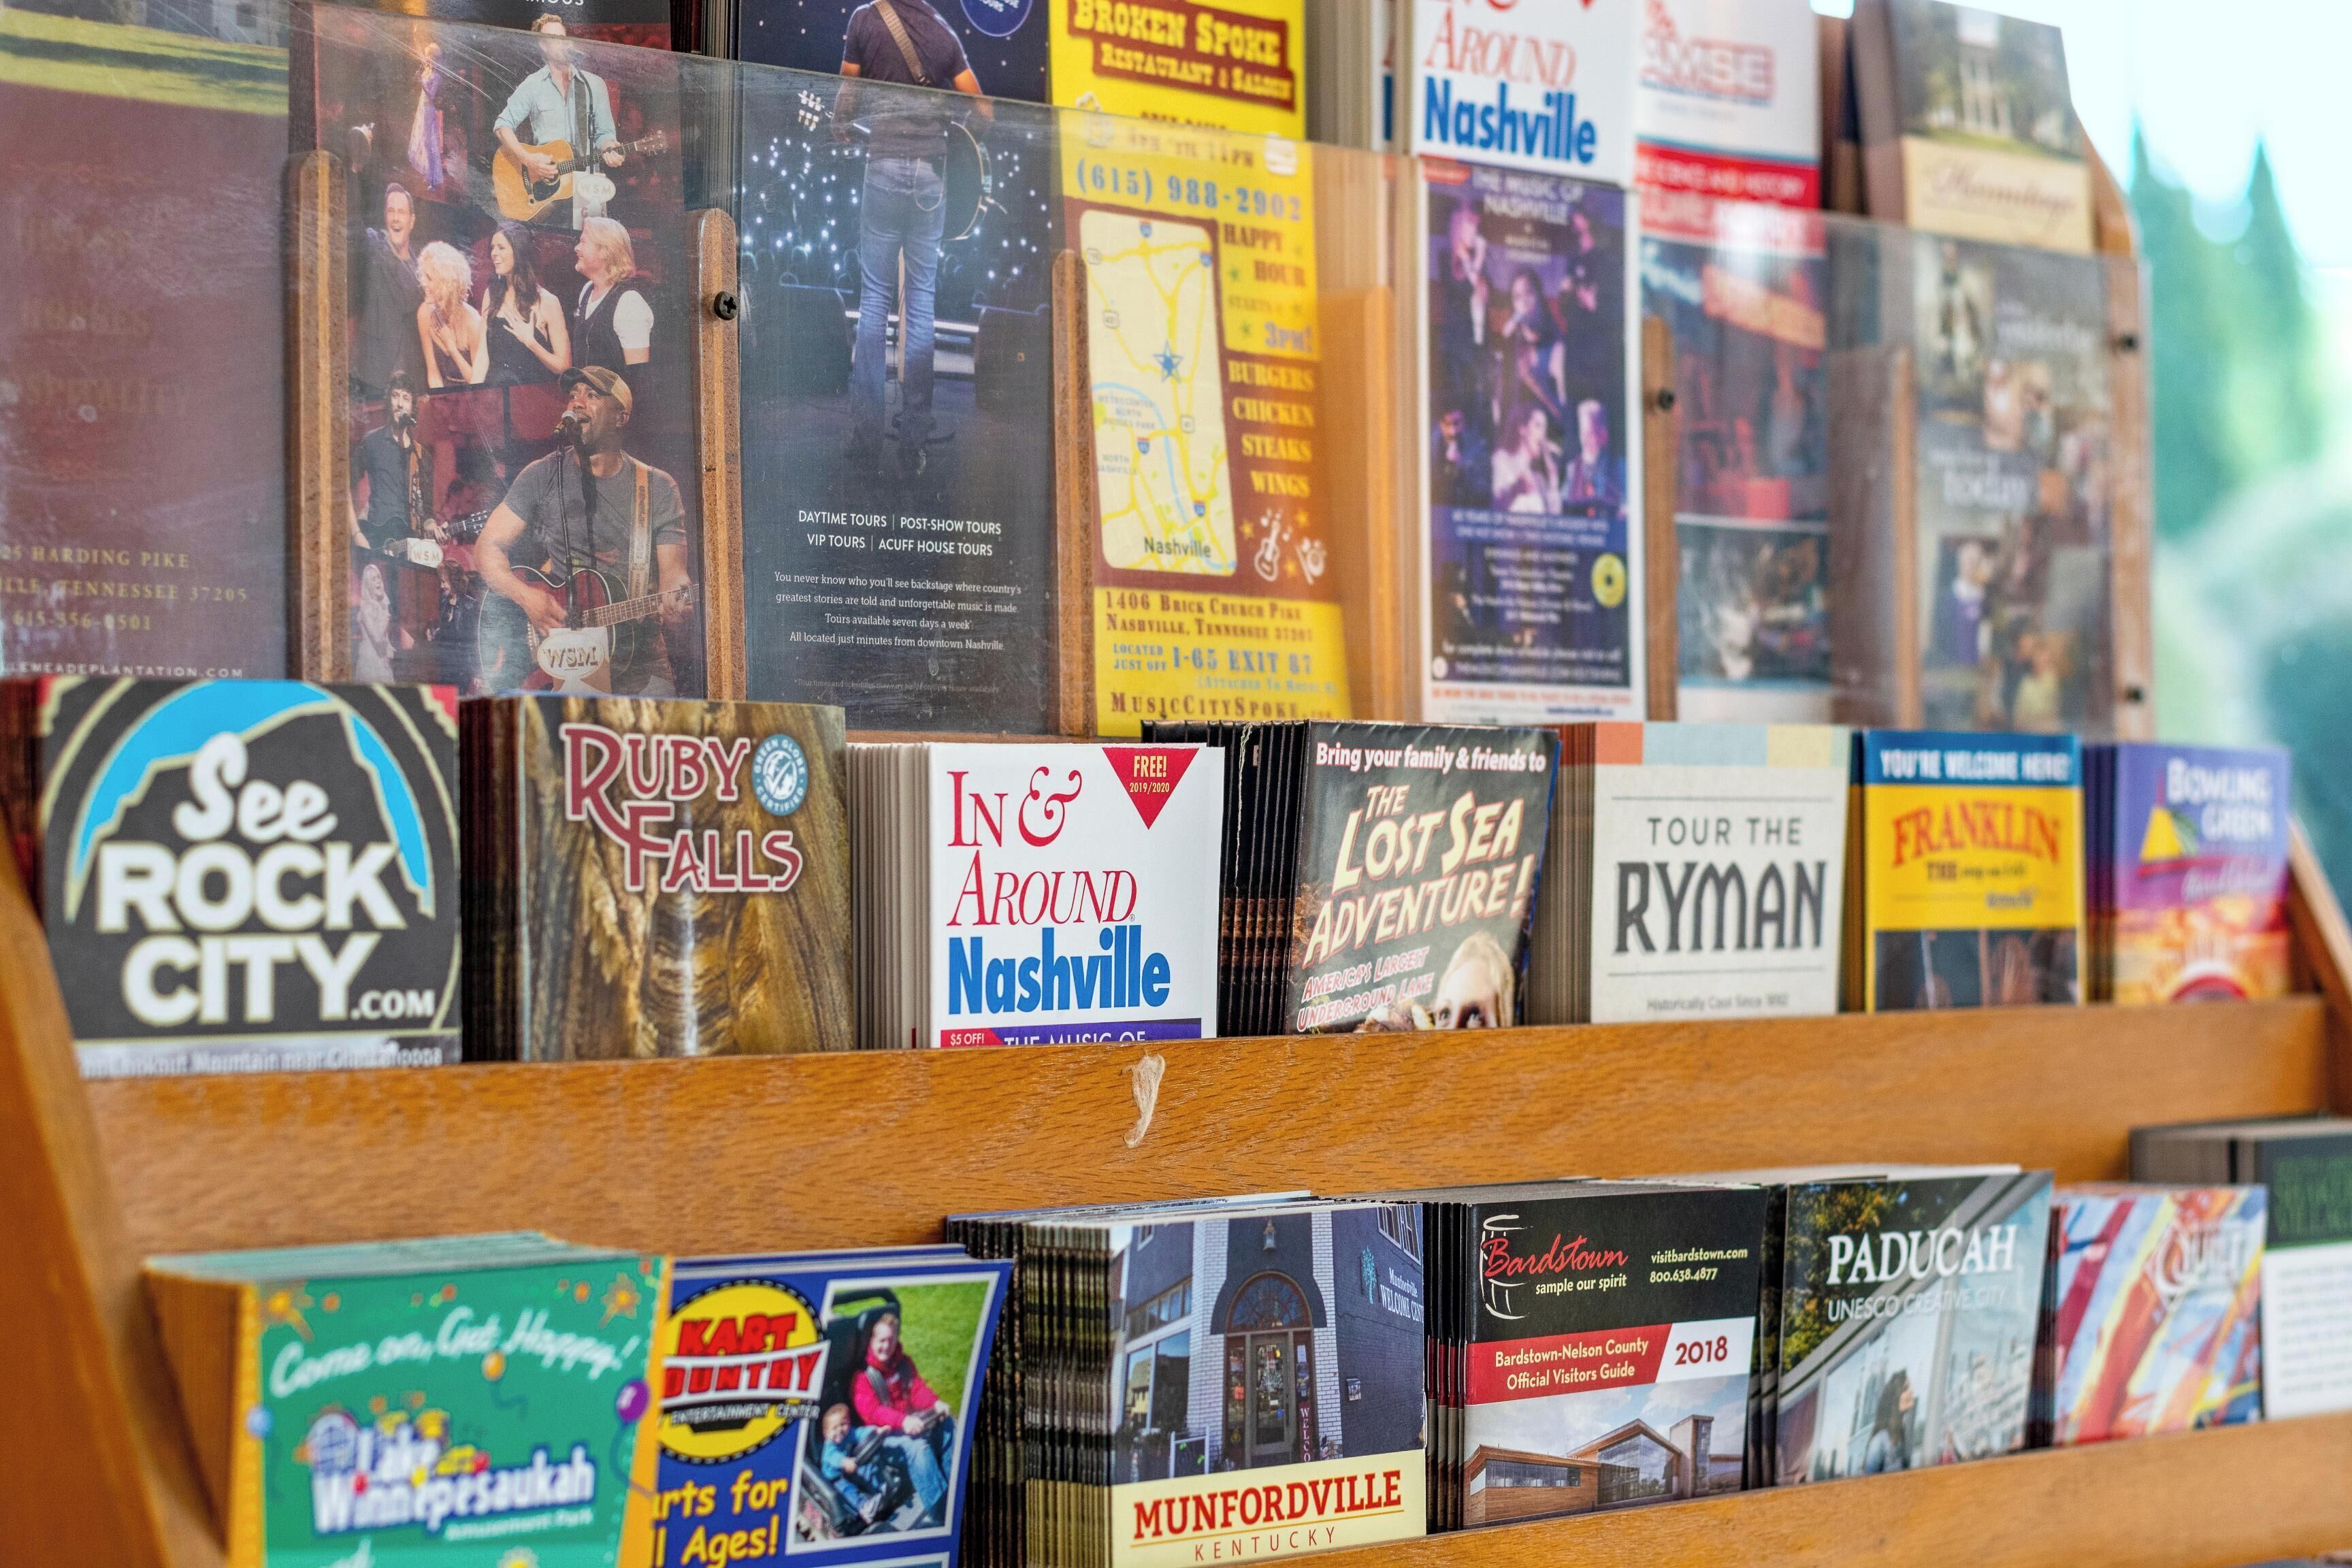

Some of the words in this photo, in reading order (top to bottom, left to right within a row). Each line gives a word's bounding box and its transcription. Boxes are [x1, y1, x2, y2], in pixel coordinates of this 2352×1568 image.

[1195, 12, 1280, 67] SPOKE
[1425, 5, 1578, 88] AROUND
[1424, 76, 1597, 165] Nashville
[1077, 157, 1153, 203] (615)
[1228, 360, 1316, 393] BURGERS
[1232, 396, 1316, 428] CHICKEN
[1241, 433, 1313, 463] STEAKS
[1250, 470, 1311, 499] WINGS
[798, 510, 847, 525] DAYTIME
[850, 512, 887, 528] TOURS
[900, 517, 964, 533] POST-SHOW
[966, 521, 1002, 536] TOURS
[32, 546, 131, 566] HARDING
[140, 551, 191, 570] PIKE
[412, 549, 440, 562] WSM
[807, 533, 827, 546] VIP
[828, 534, 866, 549] TOURS
[878, 538, 915, 552] ACUFF
[917, 540, 956, 555] HOUSE
[958, 542, 993, 557] TOURS
[1143, 536, 1211, 559] Nashville
[59, 579, 179, 600] TENNESSEE
[189, 585, 248, 603] 37205
[774, 571, 791, 583] You
[794, 574, 819, 585] never
[821, 574, 846, 585] know
[848, 576, 868, 587] who
[869, 577, 893, 590] you'll
[894, 579, 909, 589] see
[911, 578, 953, 593] backstage
[955, 581, 981, 593] where
[982, 583, 1022, 596] country's
[776, 593, 812, 604] greatest
[814, 594, 843, 605] stories
[845, 597, 859, 606] are
[861, 596, 878, 606] told
[879, 597, 896, 608] and
[898, 598, 956, 611] unforgettable
[958, 600, 983, 612] music
[985, 602, 993, 612] is
[1106, 591, 1150, 610] 1406
[825, 613, 851, 625] Tours
[852, 615, 891, 626] available
[892, 617, 917, 627] seven
[919, 617, 940, 630] days
[789, 631, 803, 642] All
[804, 632, 836, 644] located
[837, 634, 855, 647] just
[856, 635, 893, 647] minutes
[894, 636, 916, 647] from
[917, 637, 963, 649] downtown
[547, 645, 599, 668] WSM
[1173, 646, 1218, 670] I-65
[1228, 649, 1279, 673] EXIT
[559, 723, 751, 821] RUBY
[1133, 755, 1169, 779] FREE!
[1316, 742, 1362, 773] Bring
[1363, 747, 1403, 773] your
[1403, 743, 1454, 774] family
[1455, 747, 1469, 770] &
[1470, 747, 1527, 772] friends
[1528, 751, 1547, 772] to
[1880, 749, 1942, 779] YOU'RE
[1944, 750, 2019, 781] WELCOME
[174, 731, 339, 844] See
[755, 785, 804, 813] CERTIFIED
[1129, 781, 1171, 795] 2019/2020
[1365, 785, 1411, 822] THE
[947, 770, 1009, 848] IN
[1018, 766, 1083, 848] &
[622, 801, 804, 893] FALLS
[1332, 808, 1448, 897] LOST
[1440, 790, 1525, 877] SEA
[1647, 816, 1732, 847] TOUR
[1746, 817, 1803, 846] THE
[1892, 799, 2061, 868] FRANKLIN
[95, 841, 408, 934] ROCK
[1301, 853, 1536, 970] ADVENTURE!
[1614, 859, 1828, 956] RYMAN
[121, 932, 382, 1027] CITY
[948, 924, 1171, 1015] Nashville
[1301, 959, 1372, 1004] AMERICA'S
[1373, 946, 1431, 982] LARGEST
[349, 989, 436, 1020] .COM
[1296, 986, 1395, 1033] UNDERGROUND
[1398, 972, 1435, 1001] LAKE
[949, 1033, 962, 1046] $5
[963, 1032, 984, 1045] OFF!
[1482, 1232, 1629, 1278] Bardstown
[1650, 1246, 1748, 1264] visitbardstown.com
[1826, 1224, 2019, 1286] PADUCAH
[1388, 1267, 1418, 1298] Munfordville
[1535, 1279, 1574, 1296] sample
[1576, 1278, 1597, 1291] our
[1598, 1273, 1628, 1294] spirit
[1649, 1267, 1718, 1284] 800.638.4877
[1379, 1284, 1411, 1319] WELCOME
[1827, 1294, 1900, 1323] UNESCO
[676, 1311, 798, 1357] KART
[270, 1341, 372, 1398] Come
[436, 1305, 502, 1358] Get
[503, 1307, 640, 1381] Happy!
[1494, 1341, 1603, 1369] Bardstown-Nelson
[1605, 1337, 1650, 1356] County
[1674, 1335, 1729, 1367] 2018
[1506, 1369, 1550, 1391] Official
[1552, 1366, 1598, 1386] Visitors
[1599, 1360, 1635, 1379] Guide
[670, 1403, 770, 1426] ENTERTAINMENT
[775, 1403, 821, 1420] CENTER
[730, 1468, 789, 1515] for
[1133, 1469, 1402, 1541] MUNFORDVILLE
[681, 1512, 780, 1568] Ages!
[1194, 1526, 1335, 1563] KENTUCKY
